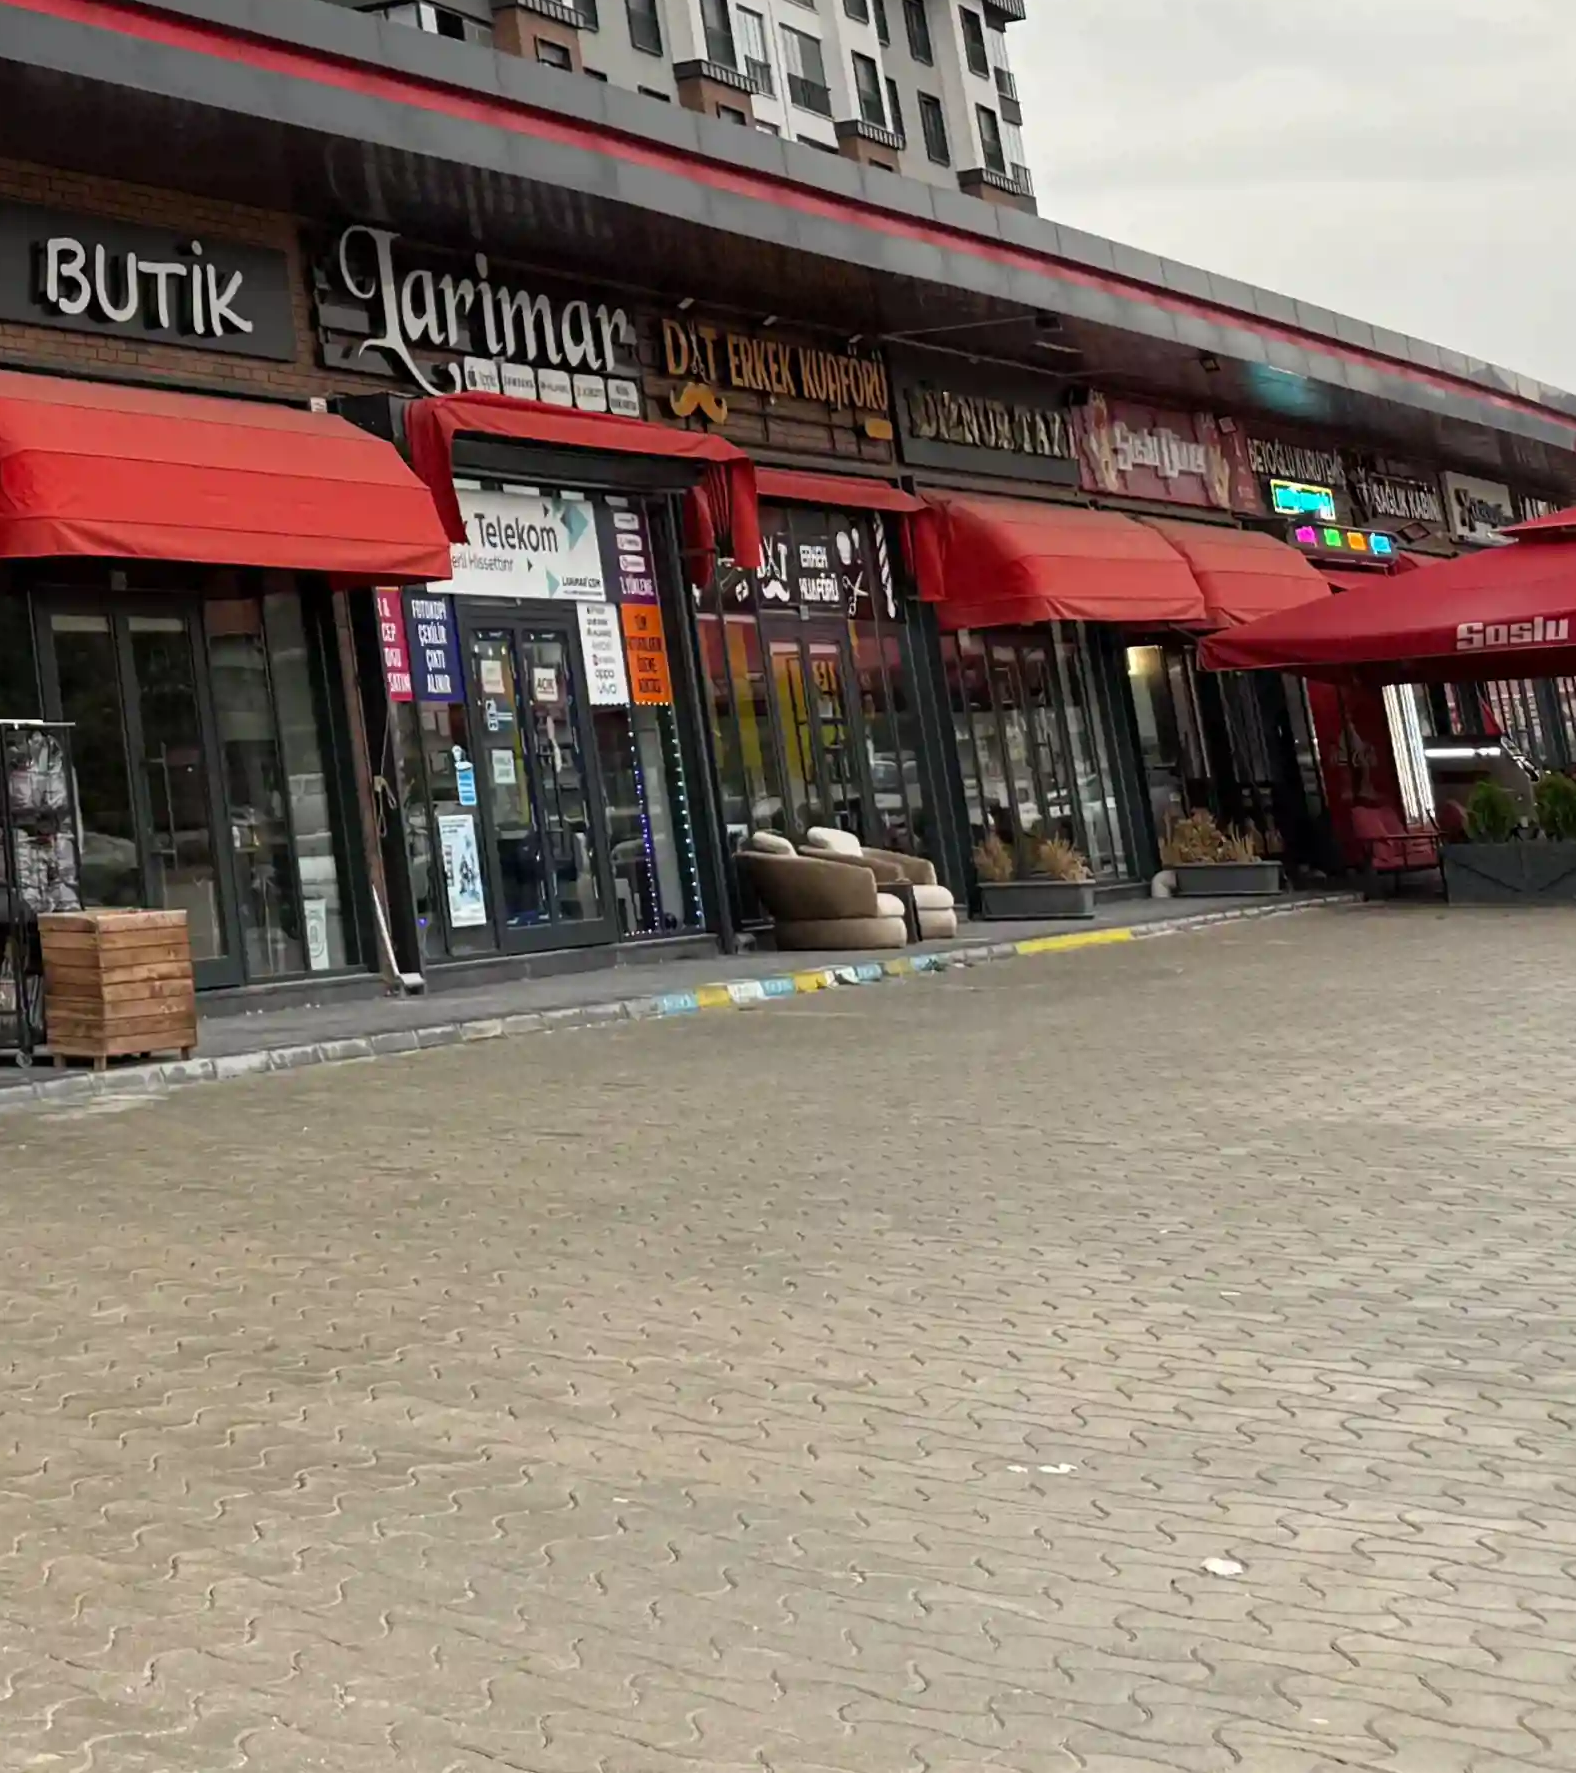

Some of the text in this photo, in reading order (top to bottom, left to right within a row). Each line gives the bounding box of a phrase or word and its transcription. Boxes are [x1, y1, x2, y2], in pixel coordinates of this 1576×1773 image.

[46, 237, 254, 338] BUTİK
[339, 224, 637, 396] Larimar
[726, 332, 796, 397] ERKEK
[798, 343, 889, 412] KUAFÖRÜ
[474, 512, 559, 554] Telekom
[411, 597, 447, 621] FOTOKOPİ
[1456, 616, 1569, 650] Soslu
